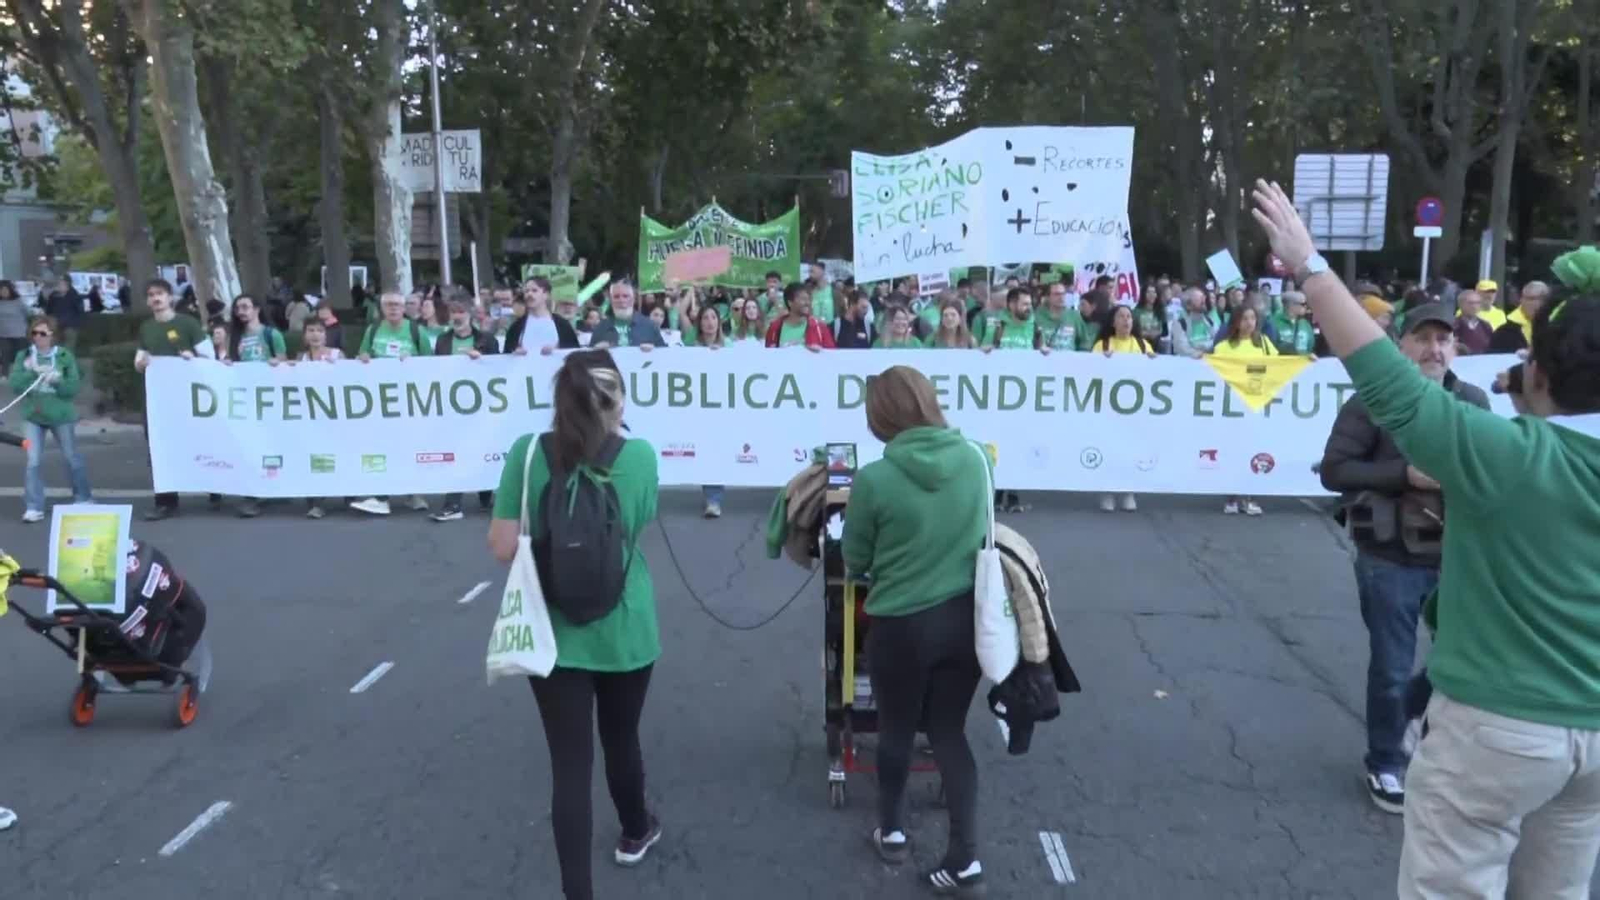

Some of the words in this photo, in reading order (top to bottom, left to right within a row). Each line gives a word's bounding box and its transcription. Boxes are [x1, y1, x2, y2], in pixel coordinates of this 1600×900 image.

[443, 136, 473, 150] CUL
[449, 151, 468, 165] TU
[459, 166, 478, 180] RA
[858, 191, 969, 234] FISCHER
[190, 377, 508, 421] DEFENDEMOS
[526, 376, 552, 411] L
[630, 361, 818, 411] ÚBLICA.
[837, 373, 1174, 417] DENDEMOS
[1193, 380, 1245, 418] EL
